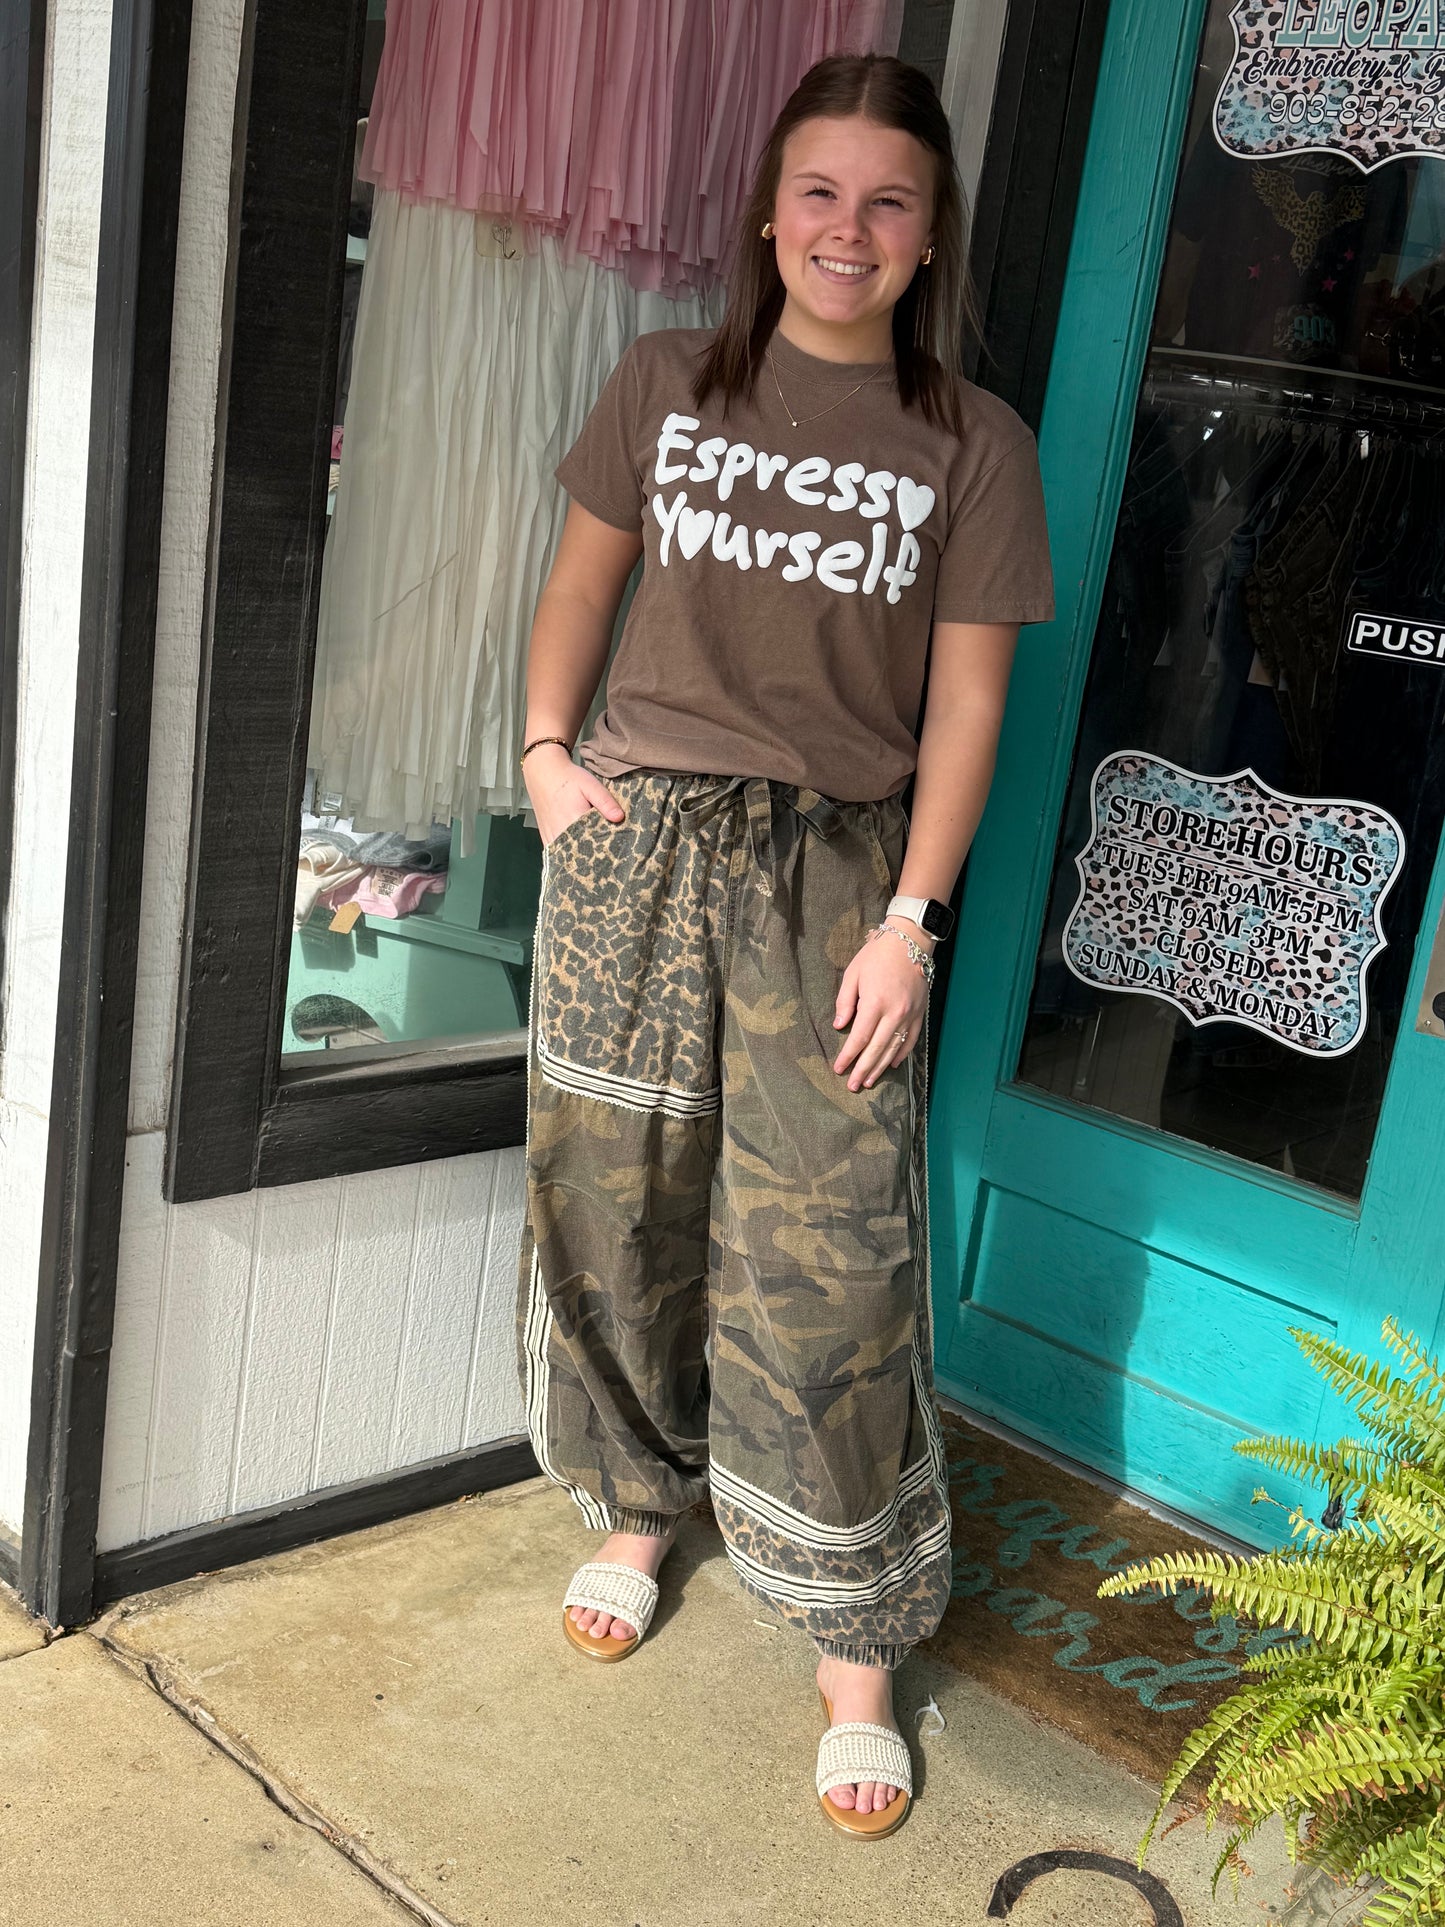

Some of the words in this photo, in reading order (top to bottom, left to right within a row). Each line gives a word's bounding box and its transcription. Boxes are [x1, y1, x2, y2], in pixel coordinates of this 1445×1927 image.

[1273, 0, 1445, 50] LEOPA
[1243, 47, 1388, 89] Embroidery
[1393, 53, 1414, 88] &
[1107, 795, 1229, 852] STORE
[1232, 825, 1375, 887] HOURS
[1101, 844, 1225, 898] TUES-FRI
[1227, 885, 1364, 933] 9AM-5PM
[1128, 888, 1180, 921] SAT
[1182, 904, 1313, 958] 9AM-3PM
[1079, 943, 1185, 993] SUNDAY
[1186, 976, 1209, 1001] &
[1215, 989, 1340, 1041] MONDAY
[1156, 931, 1266, 981] CLOSED
[949, 1548, 1241, 1712] pard
